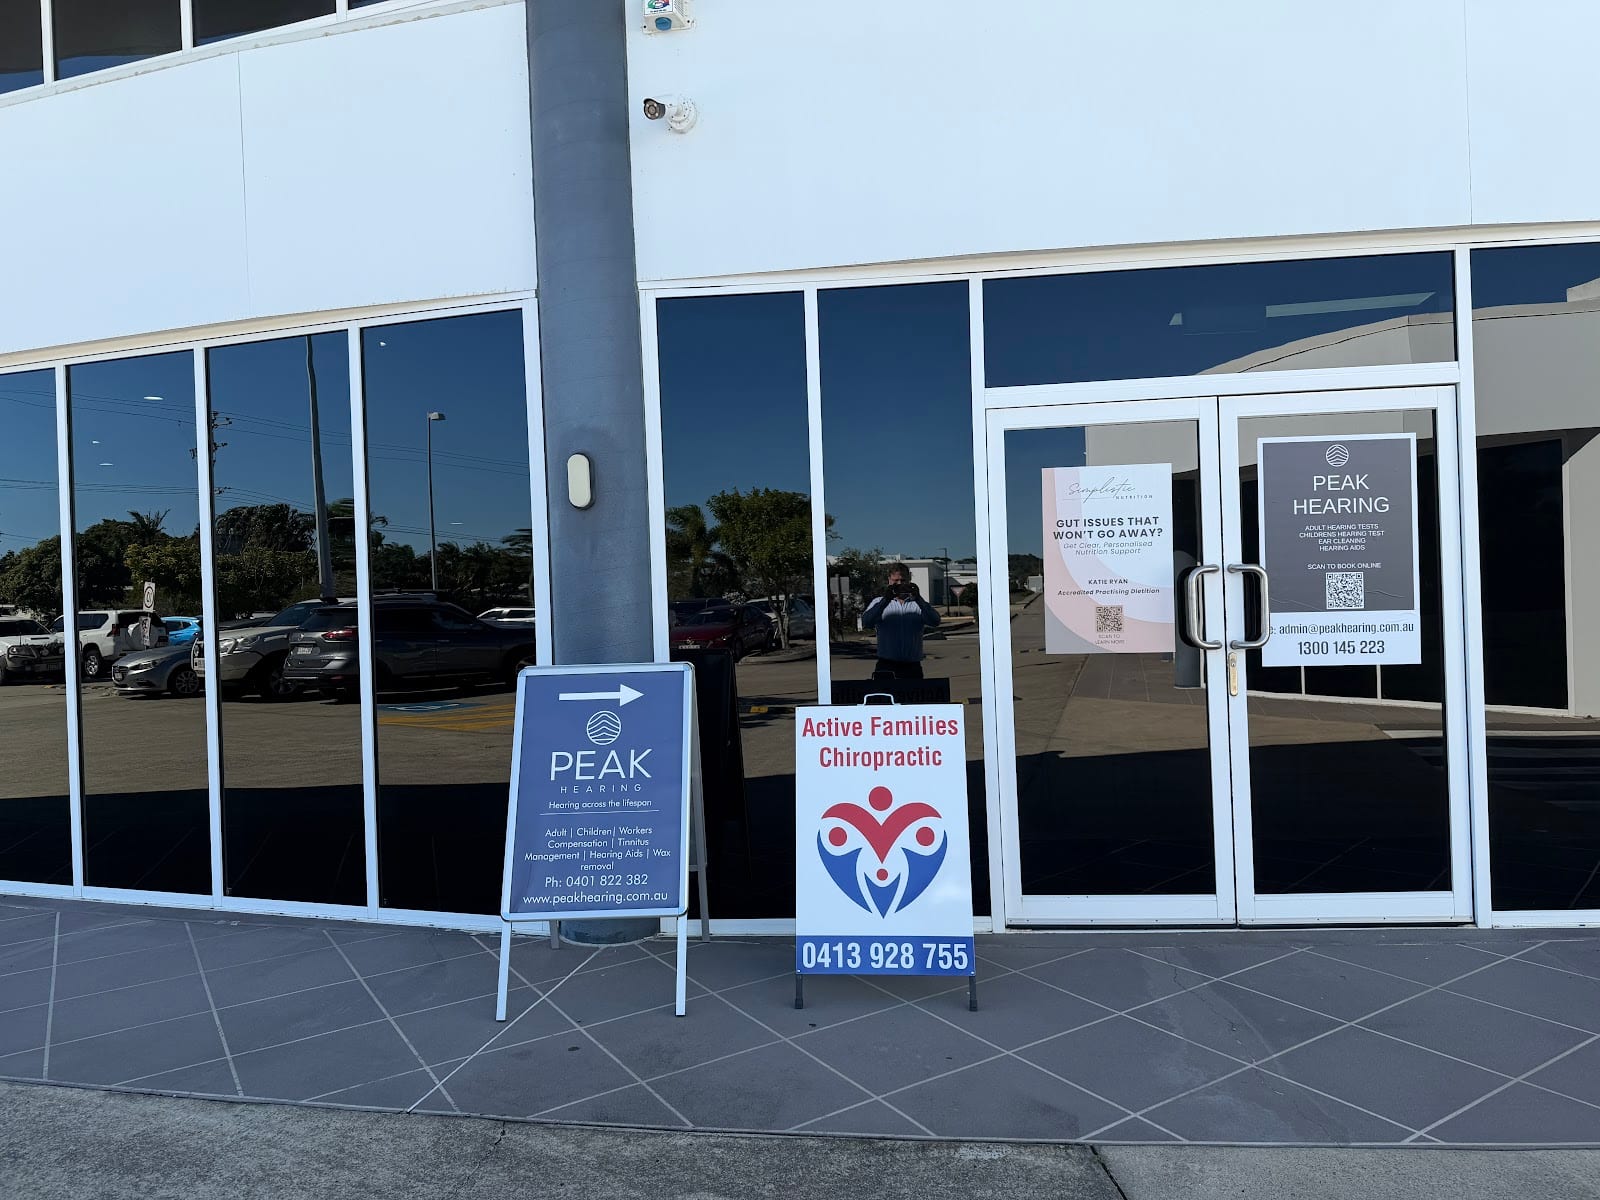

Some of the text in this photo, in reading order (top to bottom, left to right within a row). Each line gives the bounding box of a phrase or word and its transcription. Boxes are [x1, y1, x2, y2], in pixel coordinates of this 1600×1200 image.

[1313, 474, 1369, 491] PEAK
[1293, 496, 1390, 515] HEARING
[1056, 516, 1159, 528] GUT ISSUES THAT
[1053, 528, 1163, 540] WON'T GO AWAY?
[1110, 548, 1141, 556] Support
[1095, 588, 1130, 596] Practising
[1280, 622, 1414, 635] admin@peakhearing.com.au
[1298, 640, 1385, 654] 1300 145 223
[802, 716, 958, 737] Active Families
[550, 749, 652, 780] PEAK
[820, 746, 942, 771] Chiropractic
[560, 784, 642, 794] HEARING
[549, 801, 580, 810] Hearing
[622, 799, 652, 808] lifespan
[545, 828, 568, 837] Adult
[619, 826, 652, 834] Workers
[548, 840, 608, 849] Compensation
[618, 838, 649, 846] Tinnitus
[524, 852, 580, 862] Management
[590, 850, 622, 859] Hearing
[625, 849, 644, 858] Aids
[580, 862, 614, 870] removal
[545, 874, 648, 888] Ph: 0401 822 382
[523, 892, 668, 905] www.peakhearing.com.au
[802, 942, 968, 970] 0413 928 755
